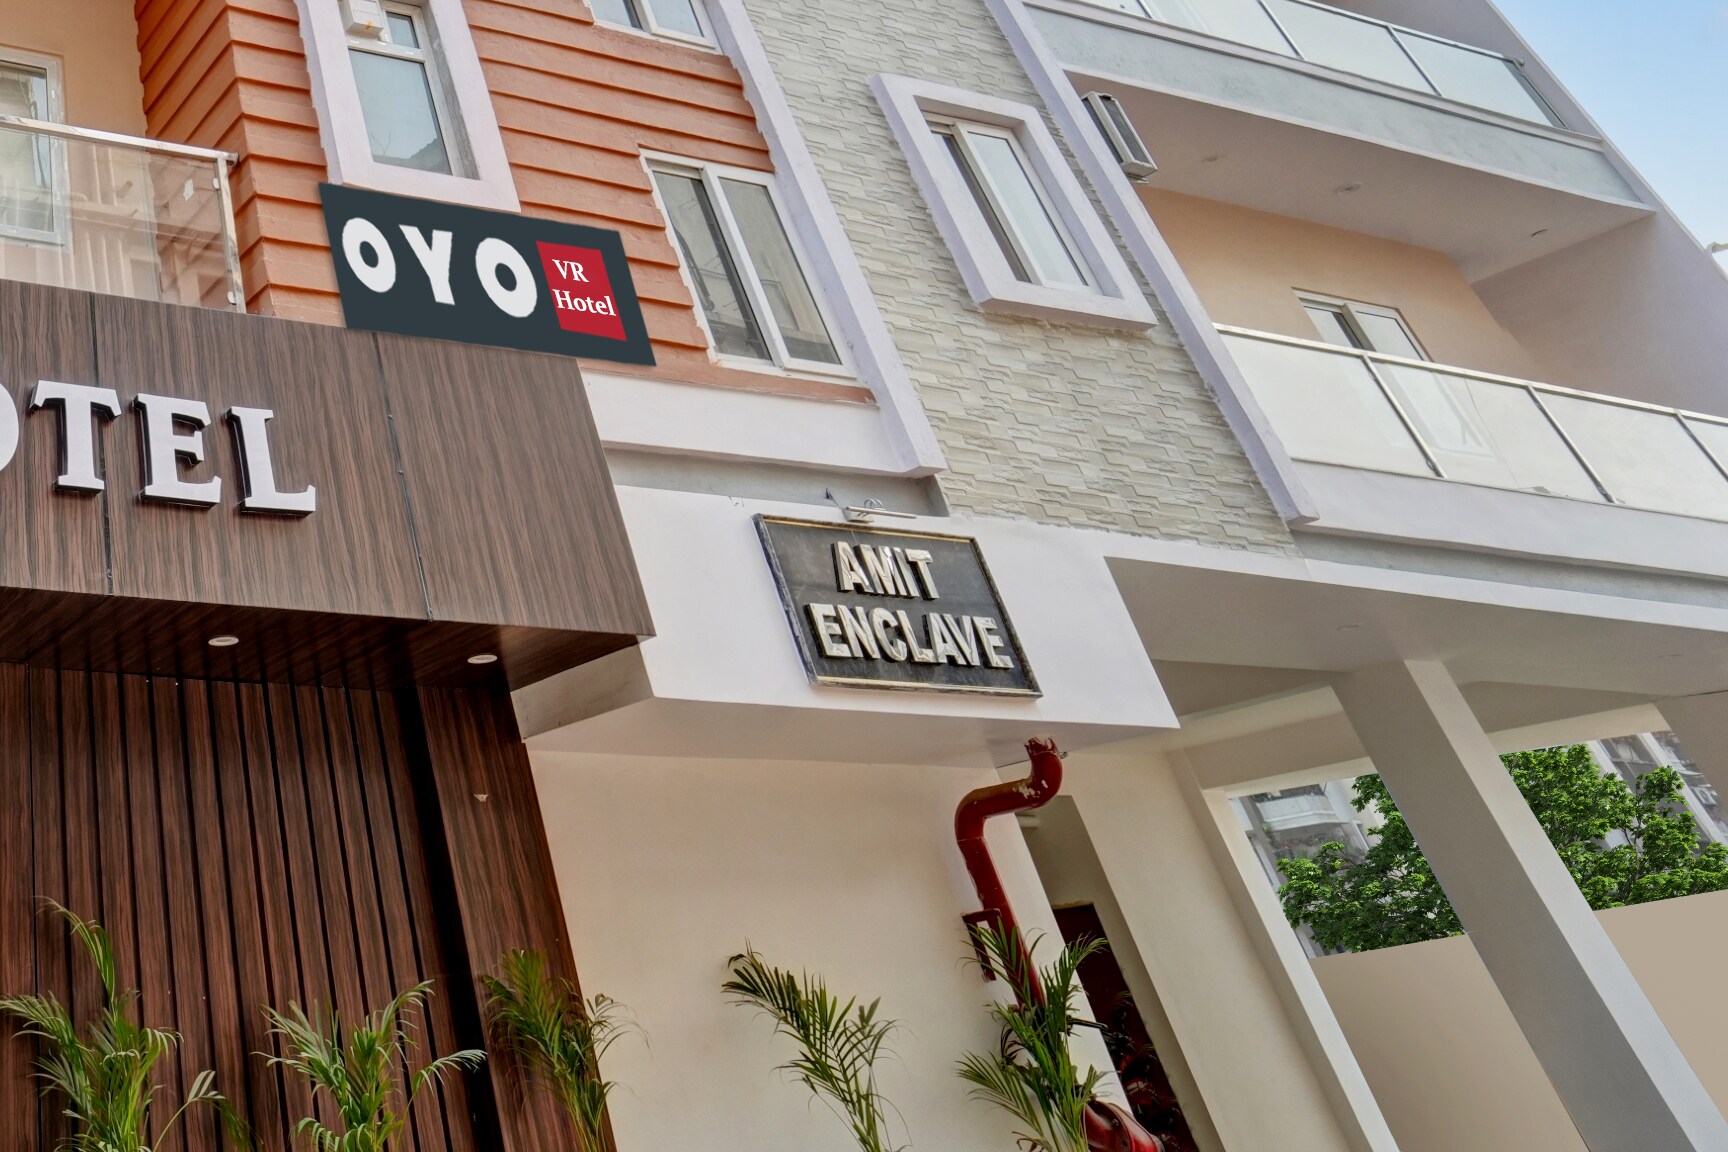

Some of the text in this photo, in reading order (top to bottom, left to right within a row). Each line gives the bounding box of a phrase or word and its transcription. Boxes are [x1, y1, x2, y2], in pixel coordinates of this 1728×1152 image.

[342, 217, 537, 318] OYO
[552, 259, 589, 282] VR
[552, 289, 616, 316] Hotel
[832, 541, 939, 599] AMIT
[805, 603, 1014, 668] ENCLAVE
